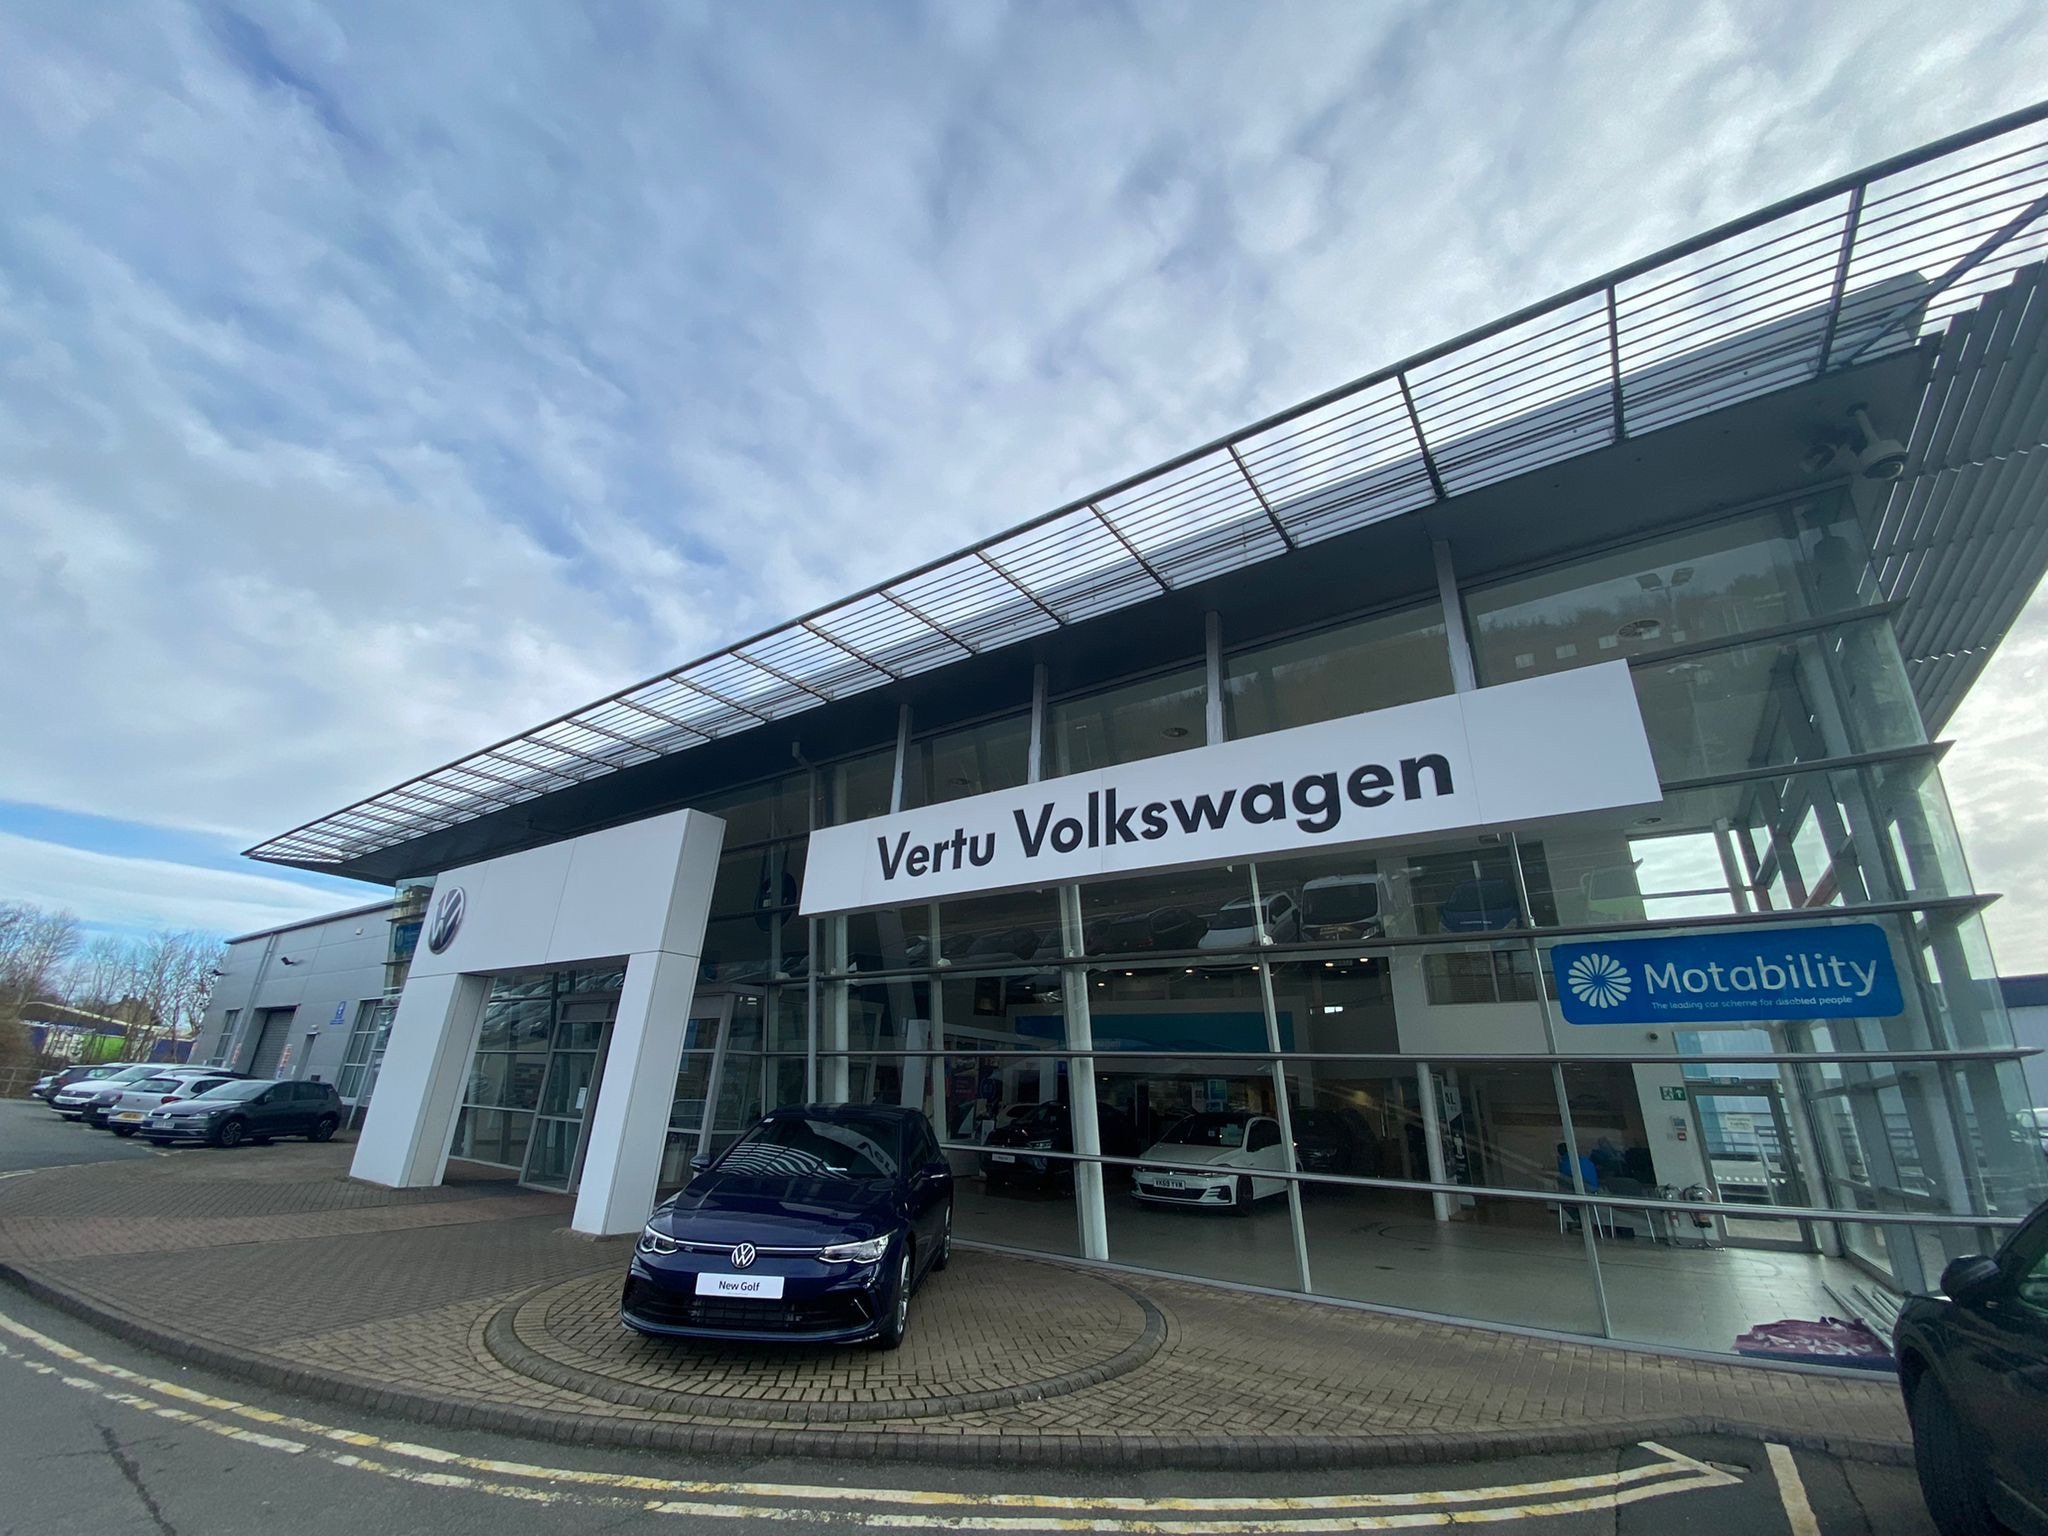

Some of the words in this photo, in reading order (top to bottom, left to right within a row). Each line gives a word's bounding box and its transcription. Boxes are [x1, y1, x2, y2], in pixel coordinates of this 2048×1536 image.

[877, 828, 996, 881] Vertu
[1012, 753, 1454, 858] Volkswagen
[1644, 953, 1877, 996] Motability
[1670, 1001, 1703, 1011] leading
[1705, 1000, 1719, 1009] car
[1721, 999, 1758, 1008] scheme
[1760, 998, 1774, 1007] for
[1775, 996, 1817, 1007] disabled
[1818, 995, 1853, 1007] people
[718, 1280, 739, 1290] New
[740, 1281, 760, 1291] Golf
